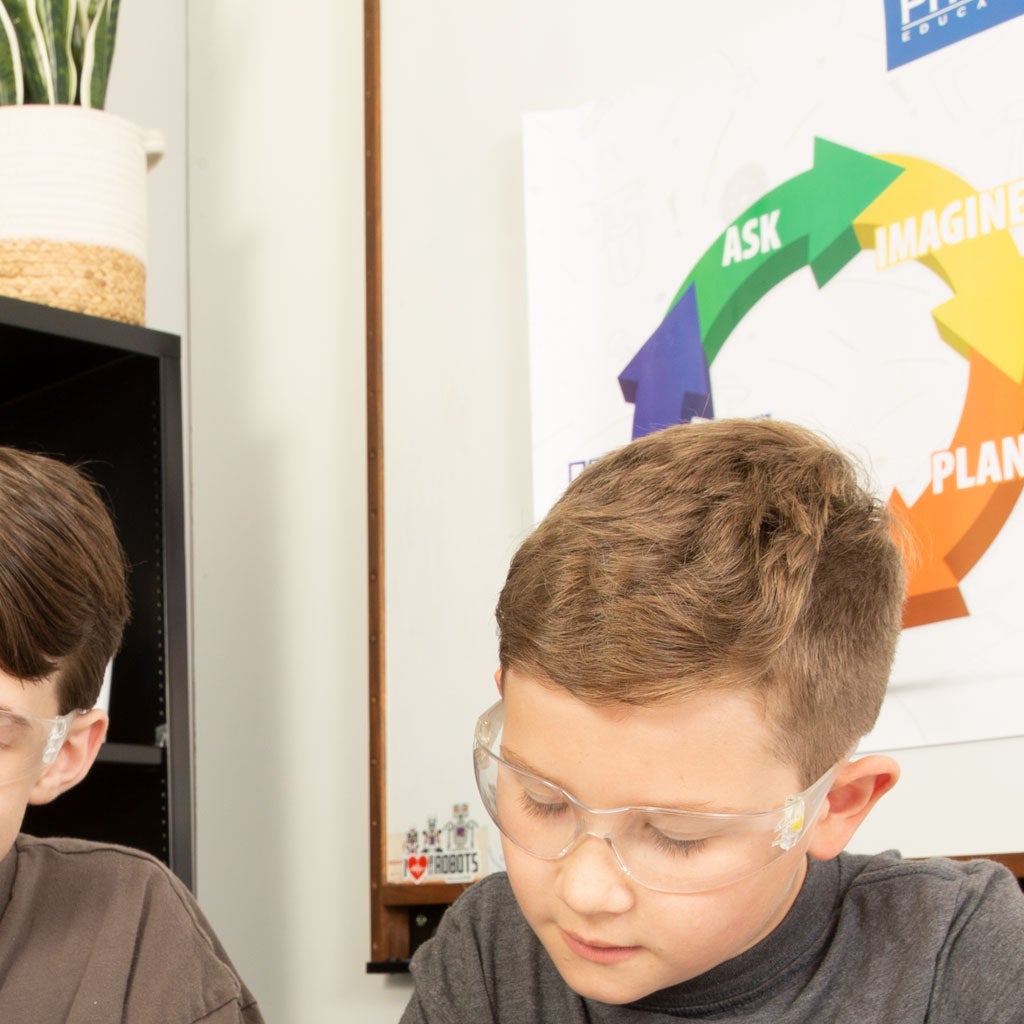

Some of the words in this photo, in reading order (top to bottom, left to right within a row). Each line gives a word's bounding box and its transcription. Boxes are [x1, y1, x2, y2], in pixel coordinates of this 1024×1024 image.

[721, 209, 782, 267] ASK
[876, 181, 1024, 269] IMAGINE
[930, 433, 1024, 495] PLAN
